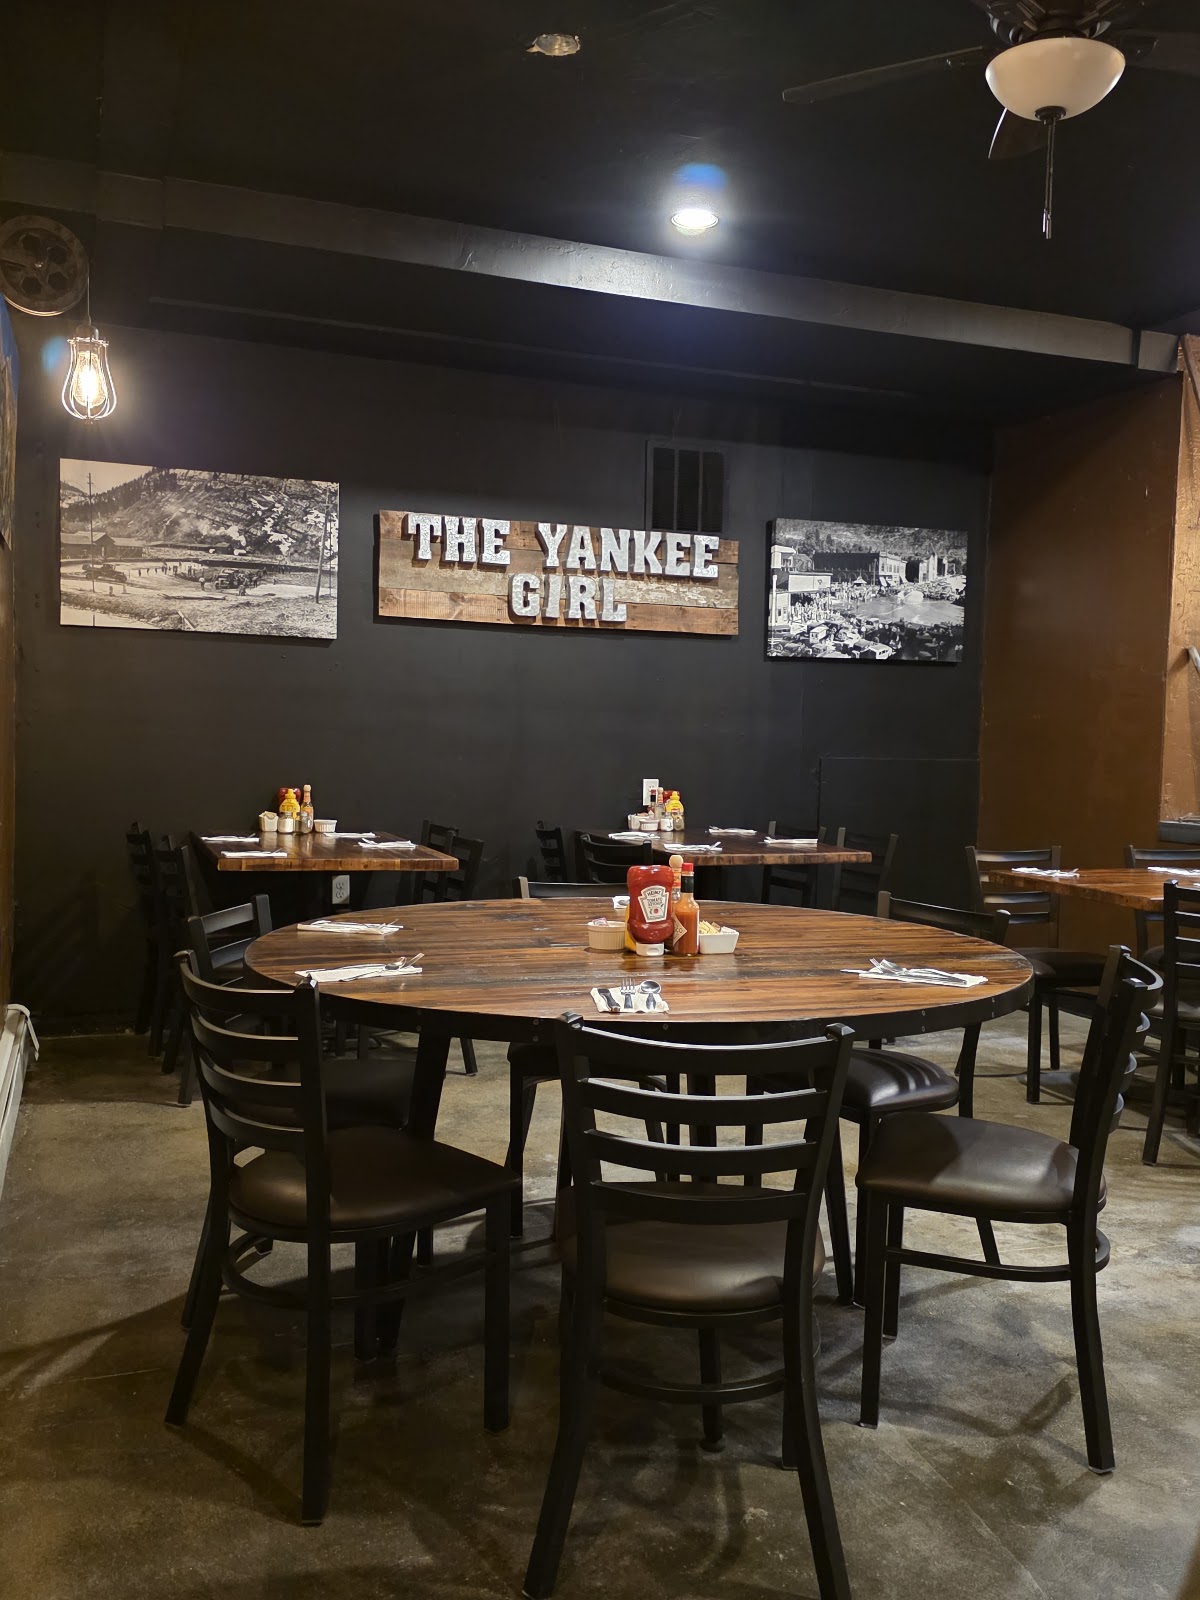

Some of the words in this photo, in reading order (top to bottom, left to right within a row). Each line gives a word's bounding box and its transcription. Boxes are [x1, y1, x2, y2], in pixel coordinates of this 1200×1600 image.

[407, 512, 511, 565] THE
[537, 522, 719, 578] YANKEE
[511, 573, 627, 622] GIRL
